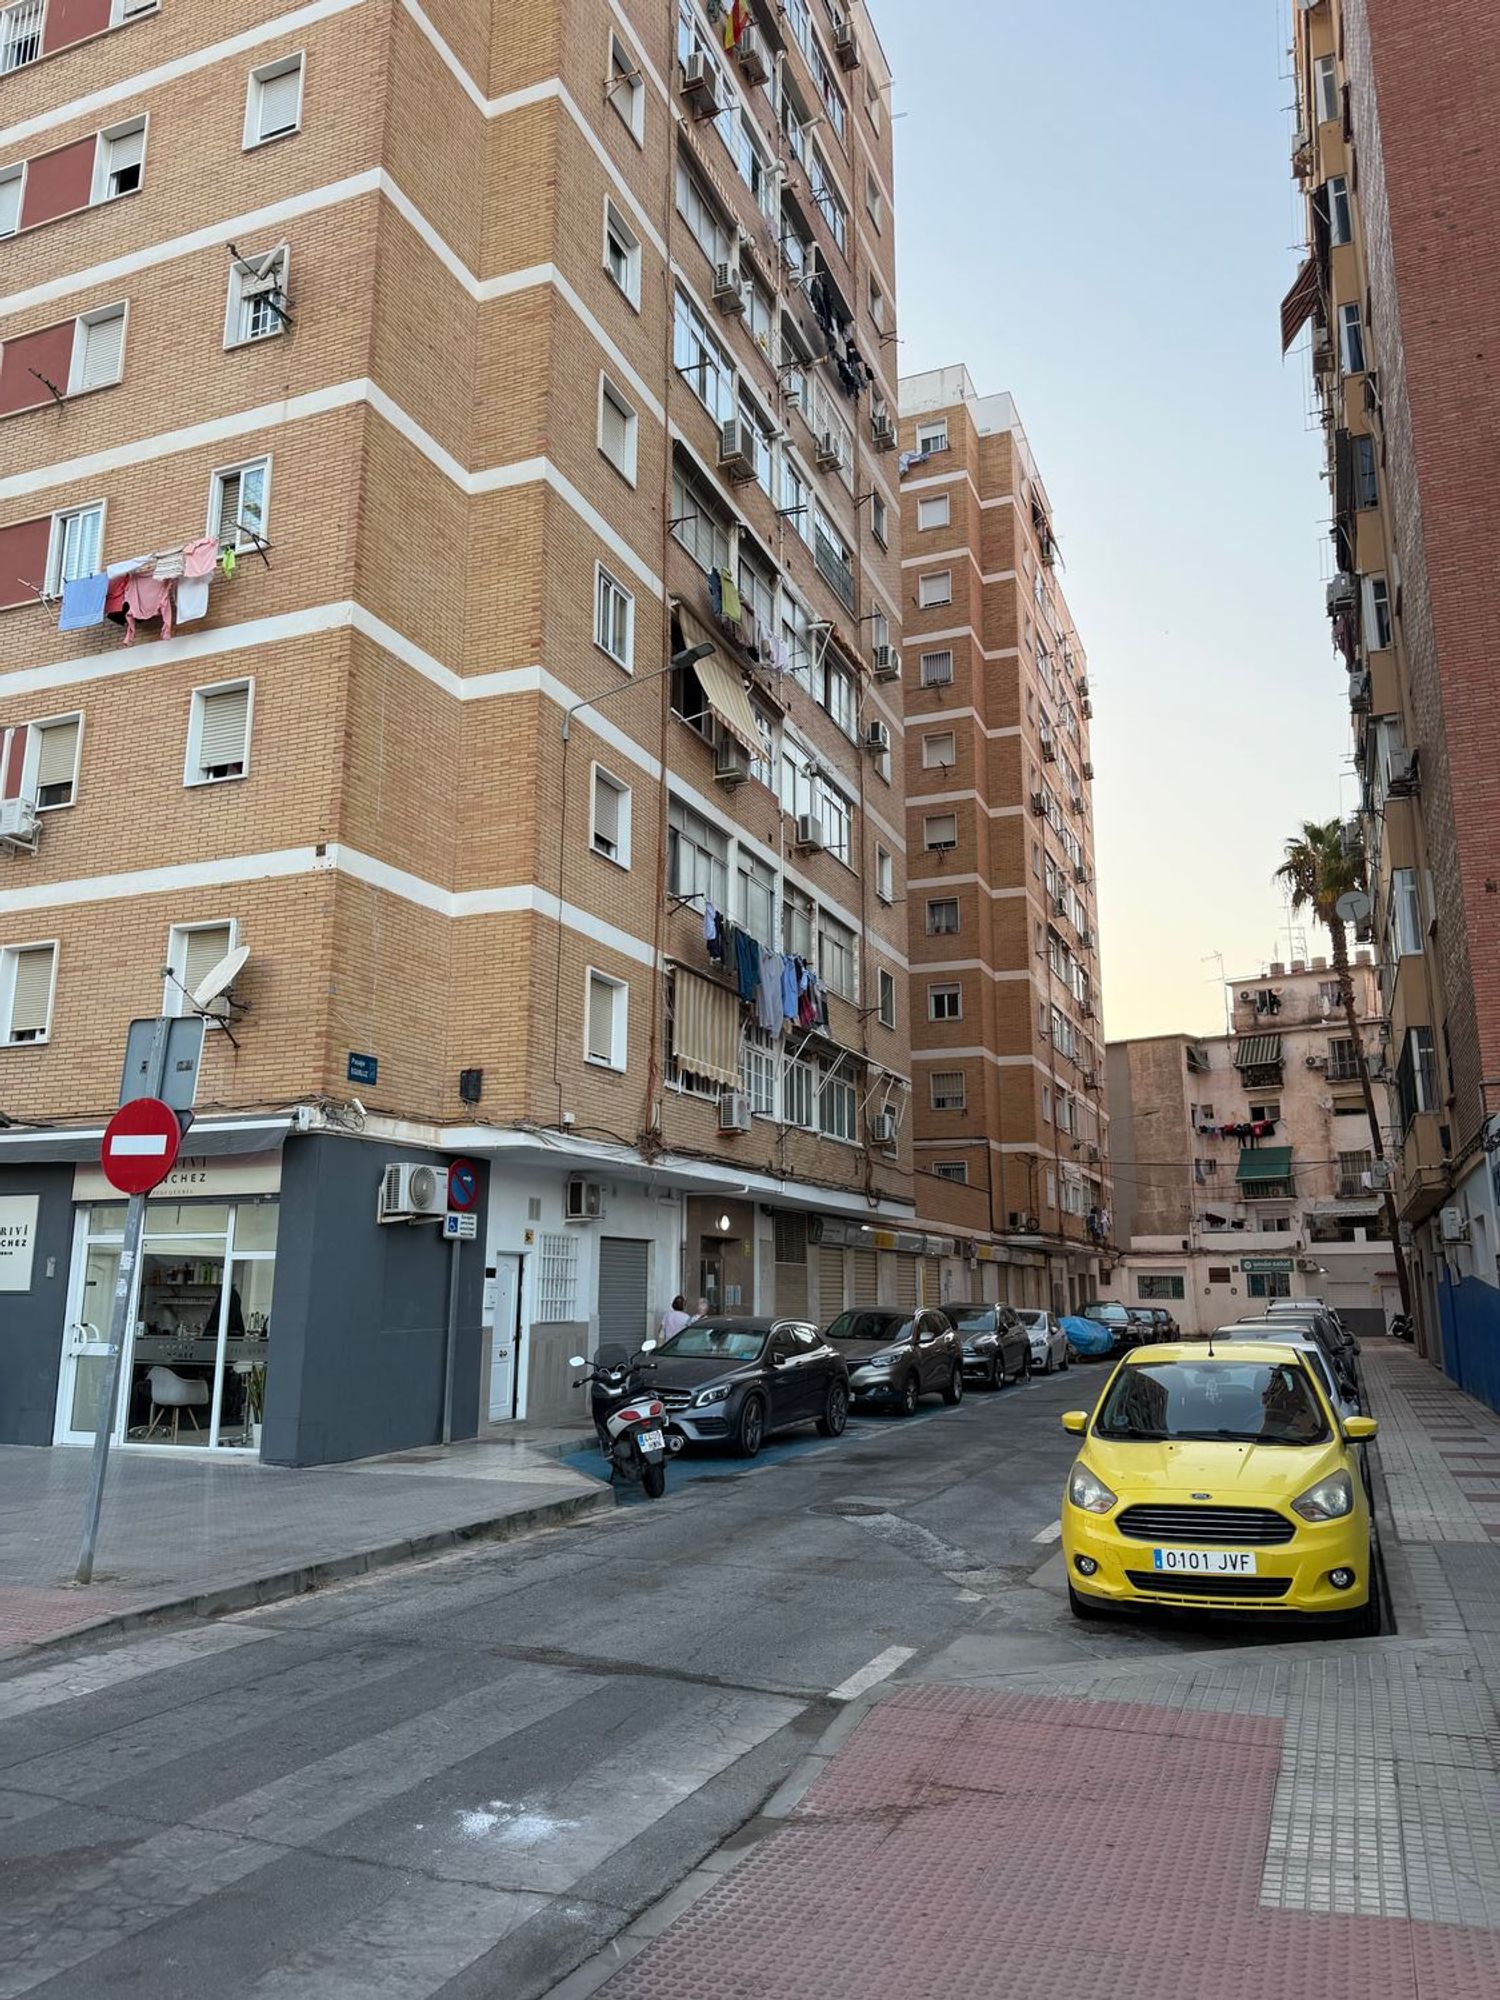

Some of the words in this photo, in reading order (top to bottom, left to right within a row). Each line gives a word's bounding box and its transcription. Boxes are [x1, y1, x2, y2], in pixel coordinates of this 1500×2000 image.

[0, 1239, 27, 1247] CHEZ
[1166, 1551, 1209, 1570] 0101
[1218, 1554, 1250, 1572] JVF
